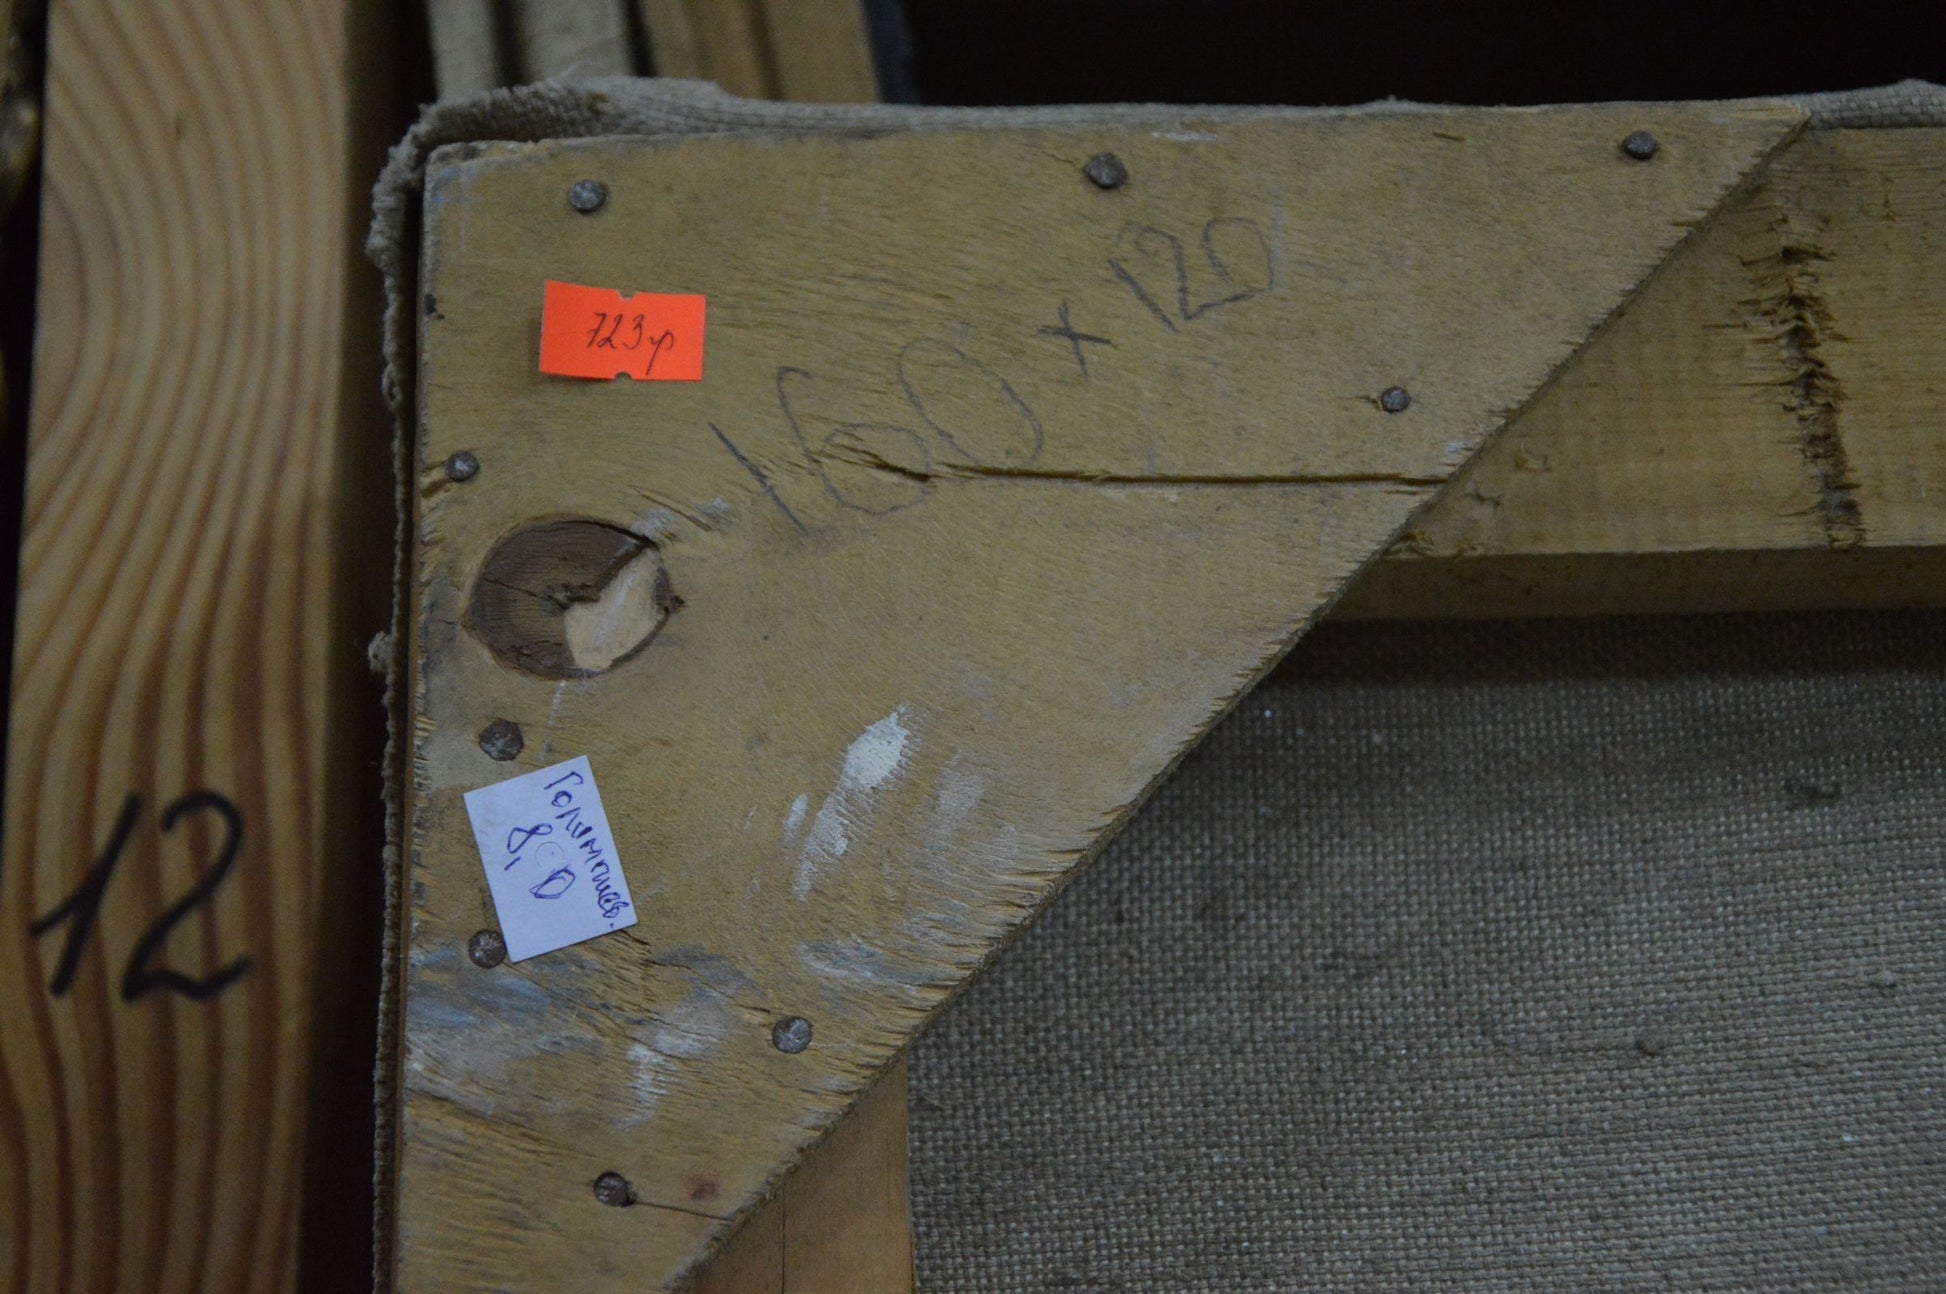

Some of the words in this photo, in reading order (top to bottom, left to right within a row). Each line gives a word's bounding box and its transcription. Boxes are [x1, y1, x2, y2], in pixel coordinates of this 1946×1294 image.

[709, 338, 1044, 535] 160
[1108, 216, 1275, 334] 120
[28, 786, 253, 1004] 12
